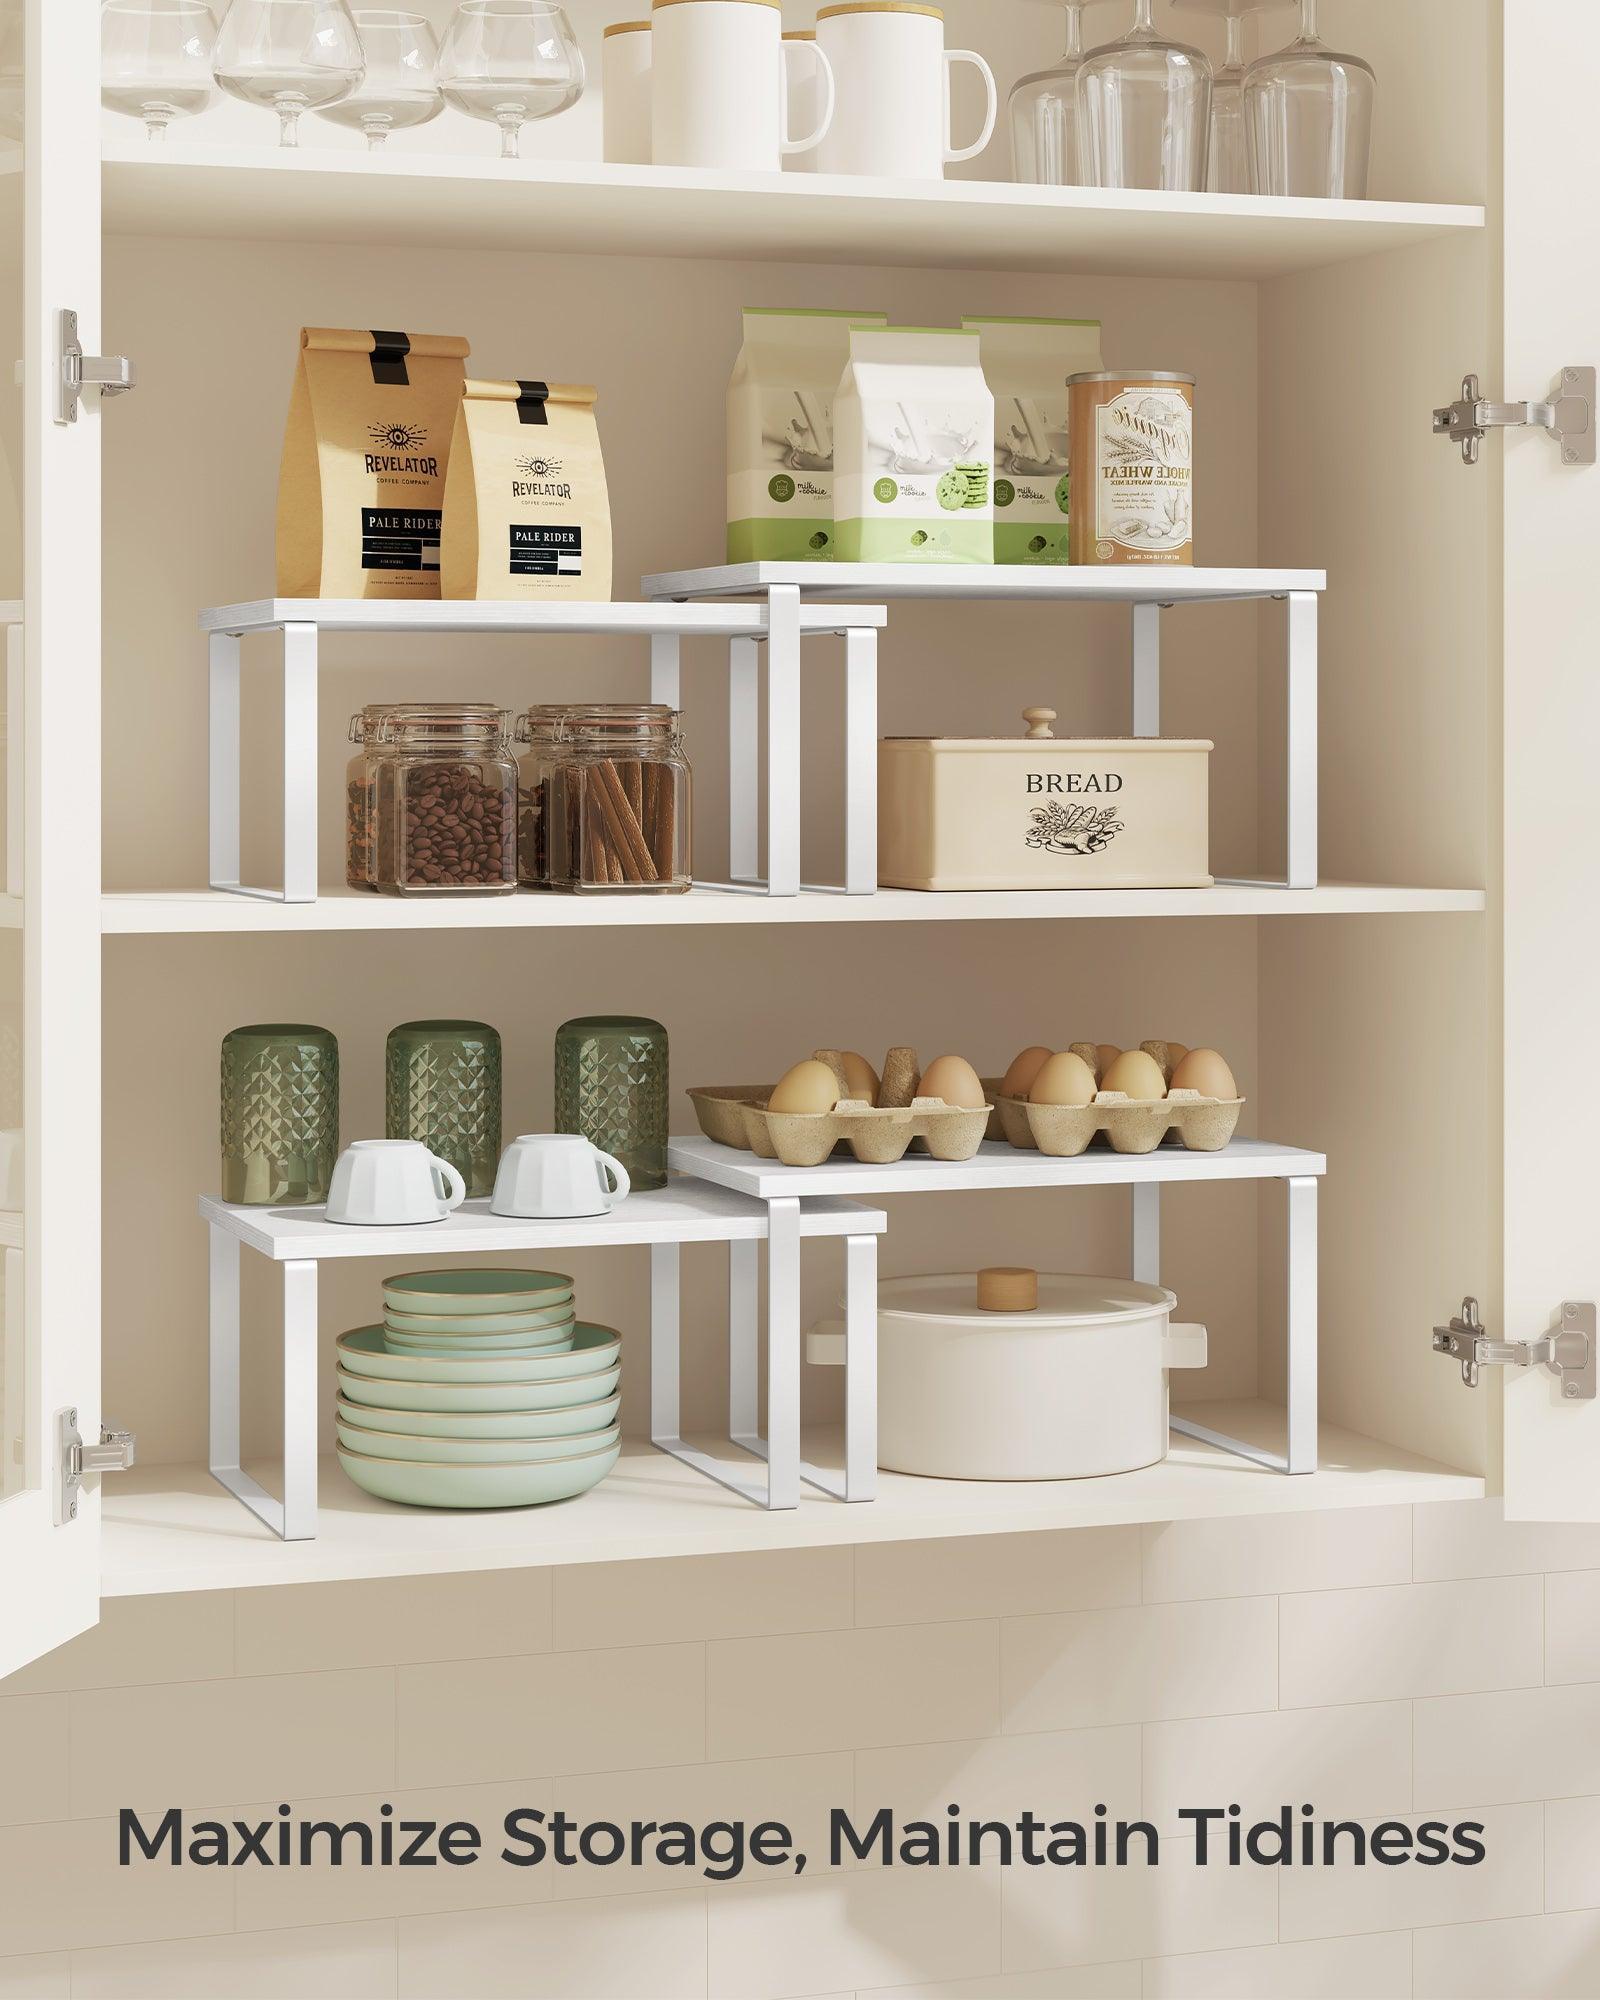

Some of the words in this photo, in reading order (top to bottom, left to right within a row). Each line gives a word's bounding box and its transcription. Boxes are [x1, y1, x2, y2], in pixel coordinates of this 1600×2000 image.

[365, 454, 438, 477] REVELATOR
[512, 481, 571, 500] REVELATOR
[369, 516, 400, 528] PALE
[404, 518, 442, 529] RIDER
[516, 531, 541, 542] PALE
[544, 532, 575, 542] RIDER
[1026, 773, 1122, 793] BREAD
